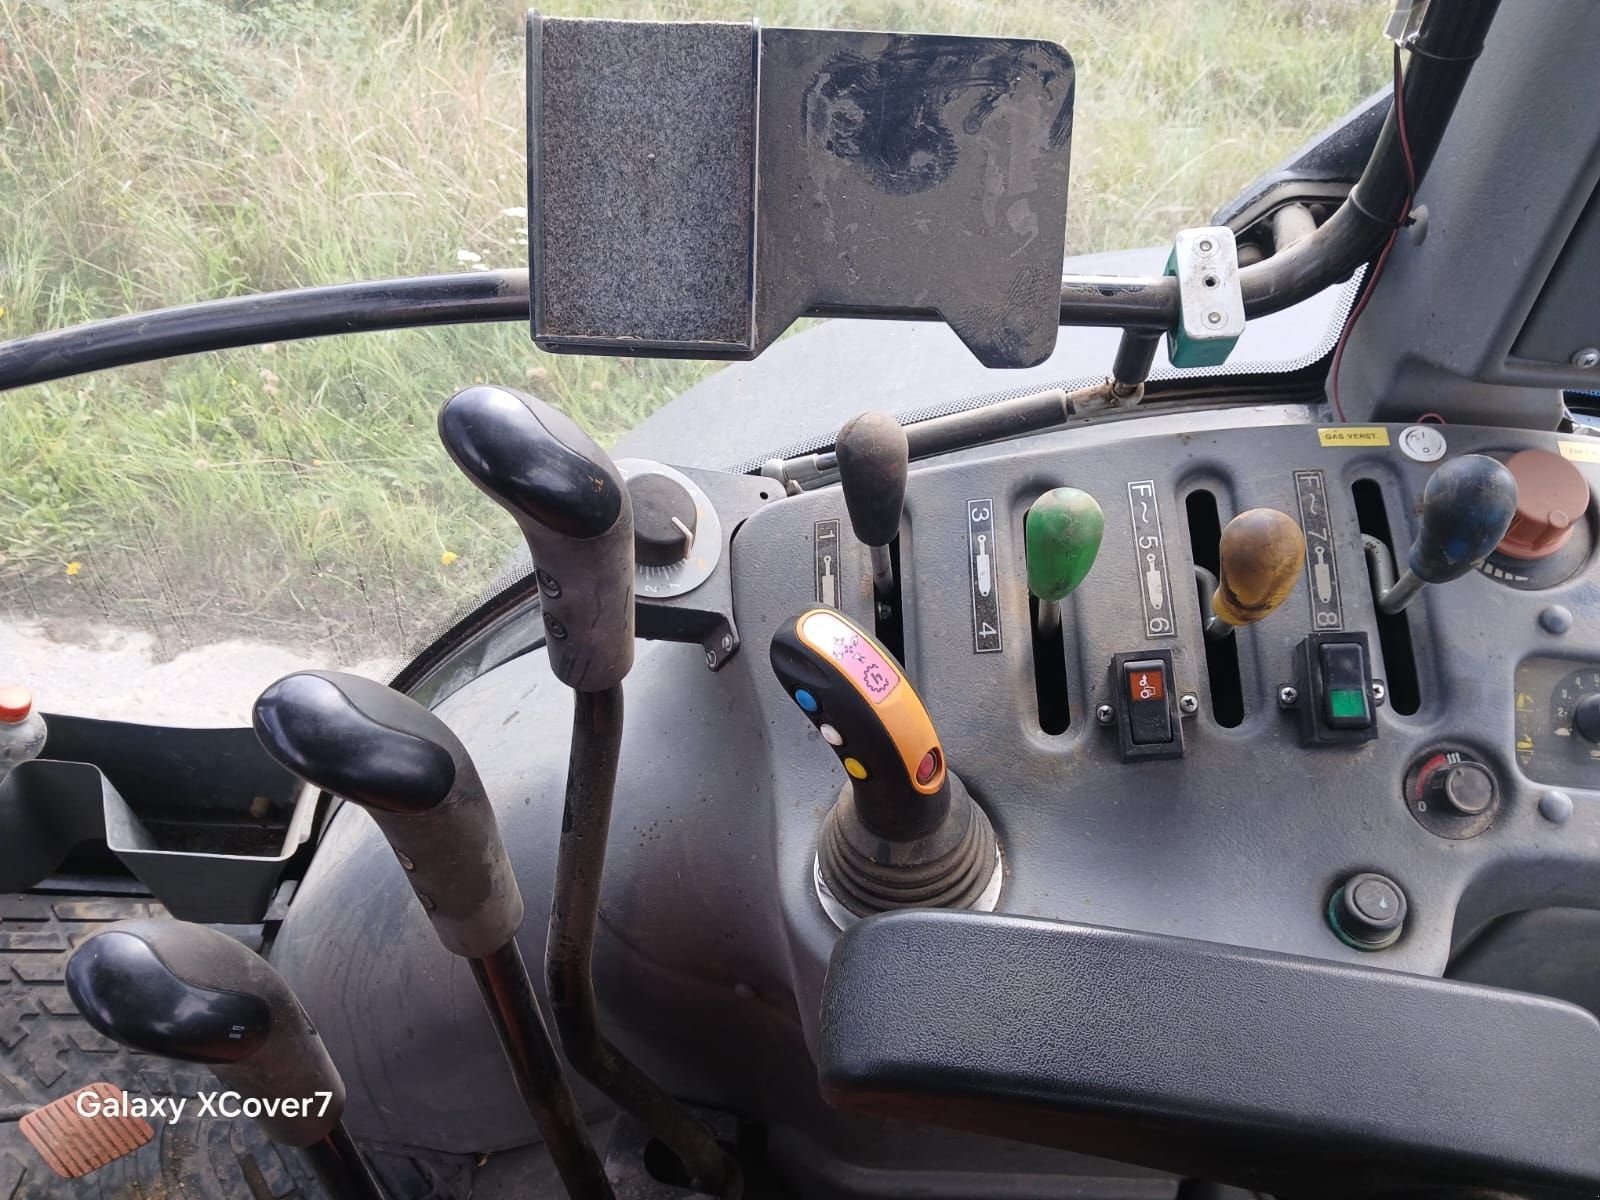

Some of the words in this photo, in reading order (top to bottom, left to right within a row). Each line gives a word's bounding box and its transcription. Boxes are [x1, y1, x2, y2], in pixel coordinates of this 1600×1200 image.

[1325, 432, 1344, 440] GAS
[1299, 475, 1320, 489] F
[1132, 484, 1152, 497] F
[971, 507, 990, 522] 3
[819, 529, 836, 540] 1
[1308, 528, 1328, 542] 7
[1139, 536, 1159, 549] 5
[1149, 617, 1170, 632] 6
[1316, 611, 1338, 626] 8
[978, 622, 998, 639] 4
